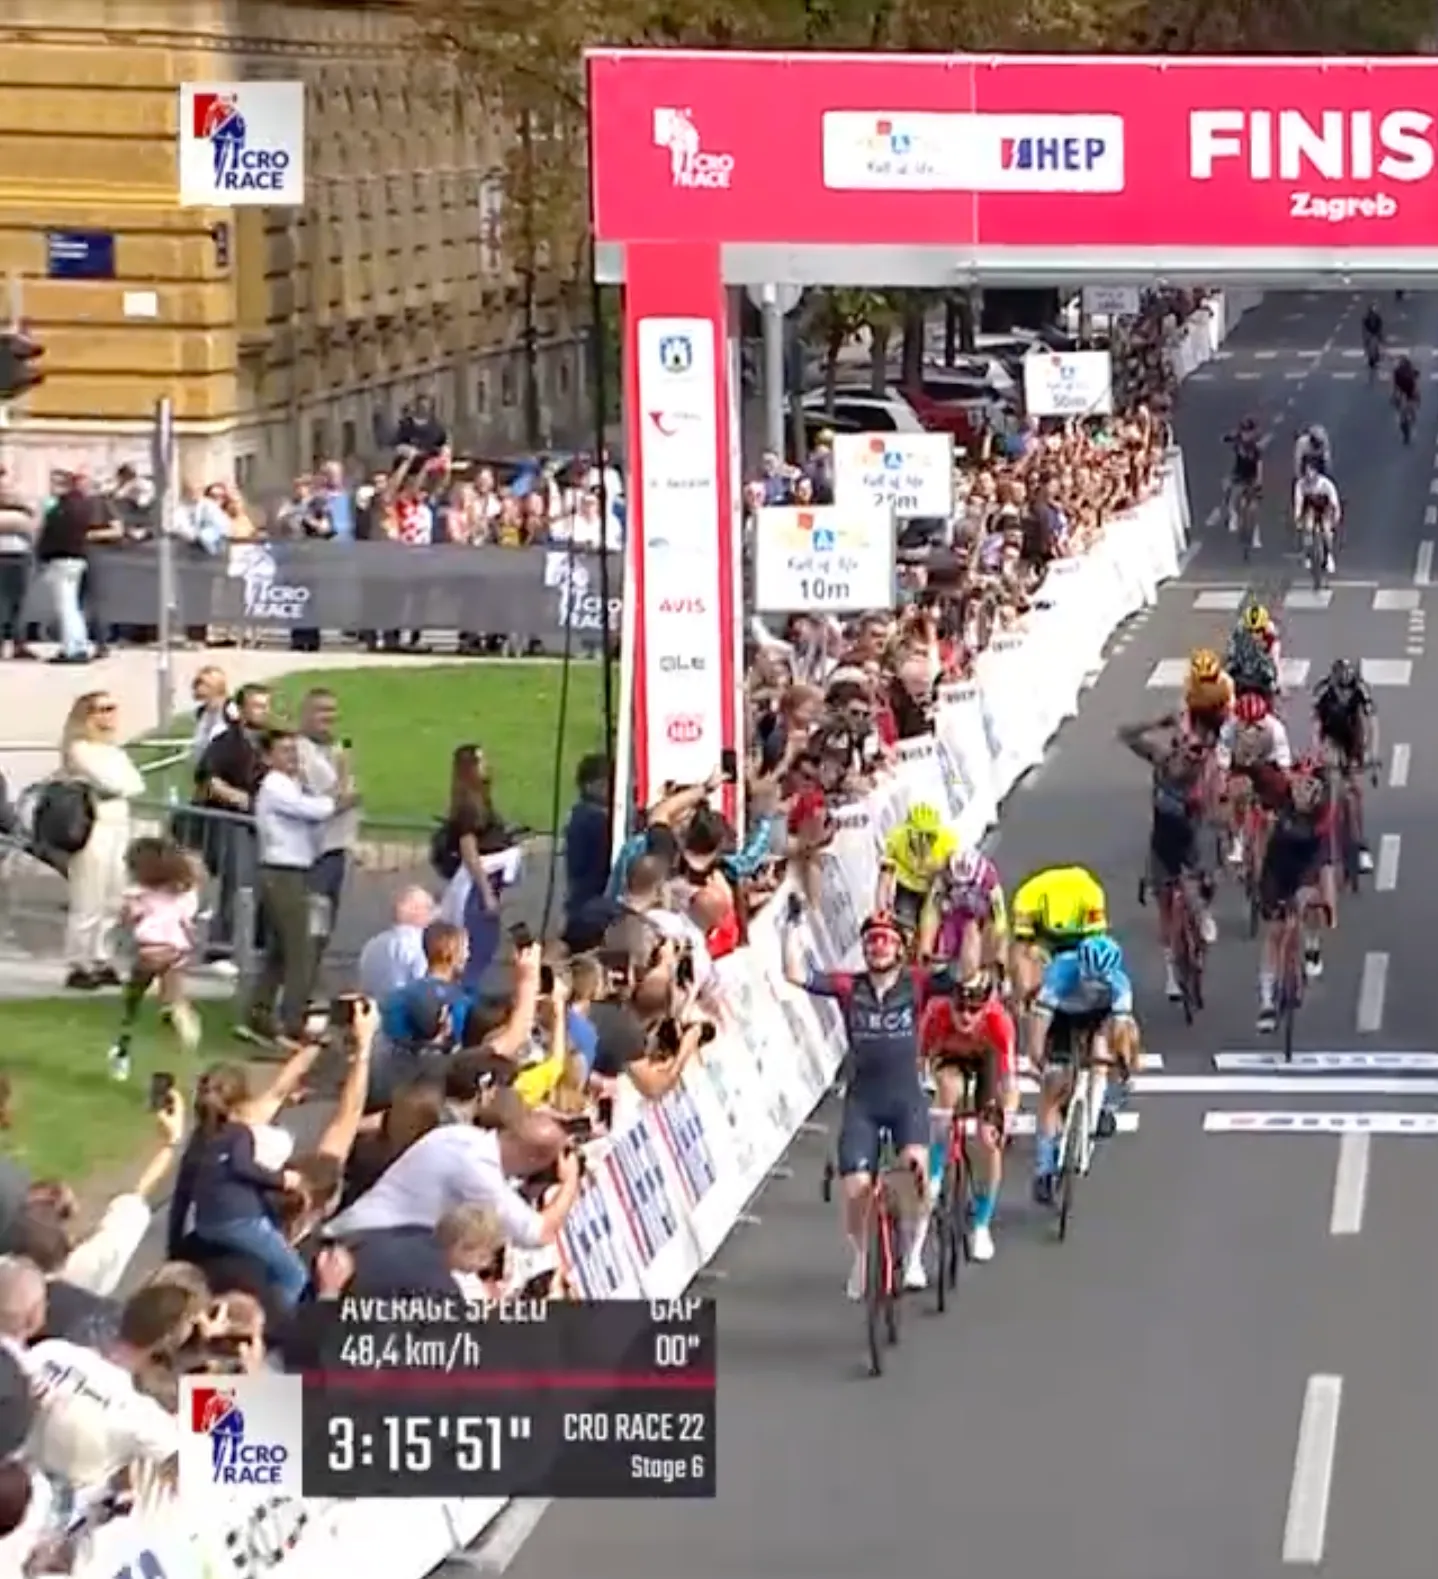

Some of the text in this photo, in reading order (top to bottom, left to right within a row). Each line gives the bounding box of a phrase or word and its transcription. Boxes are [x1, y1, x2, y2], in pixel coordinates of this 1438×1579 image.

[1037, 137, 1106, 170] HEP
[692, 156, 735, 171] CRO
[681, 171, 731, 188] RACE
[1289, 192, 1398, 221] Zagreb
[268, 586, 310, 602] CRO
[799, 578, 850, 599] 10m
[252, 603, 304, 619] RACE
[583, 597, 623, 612] CO
[658, 598, 706, 614] AVIS
